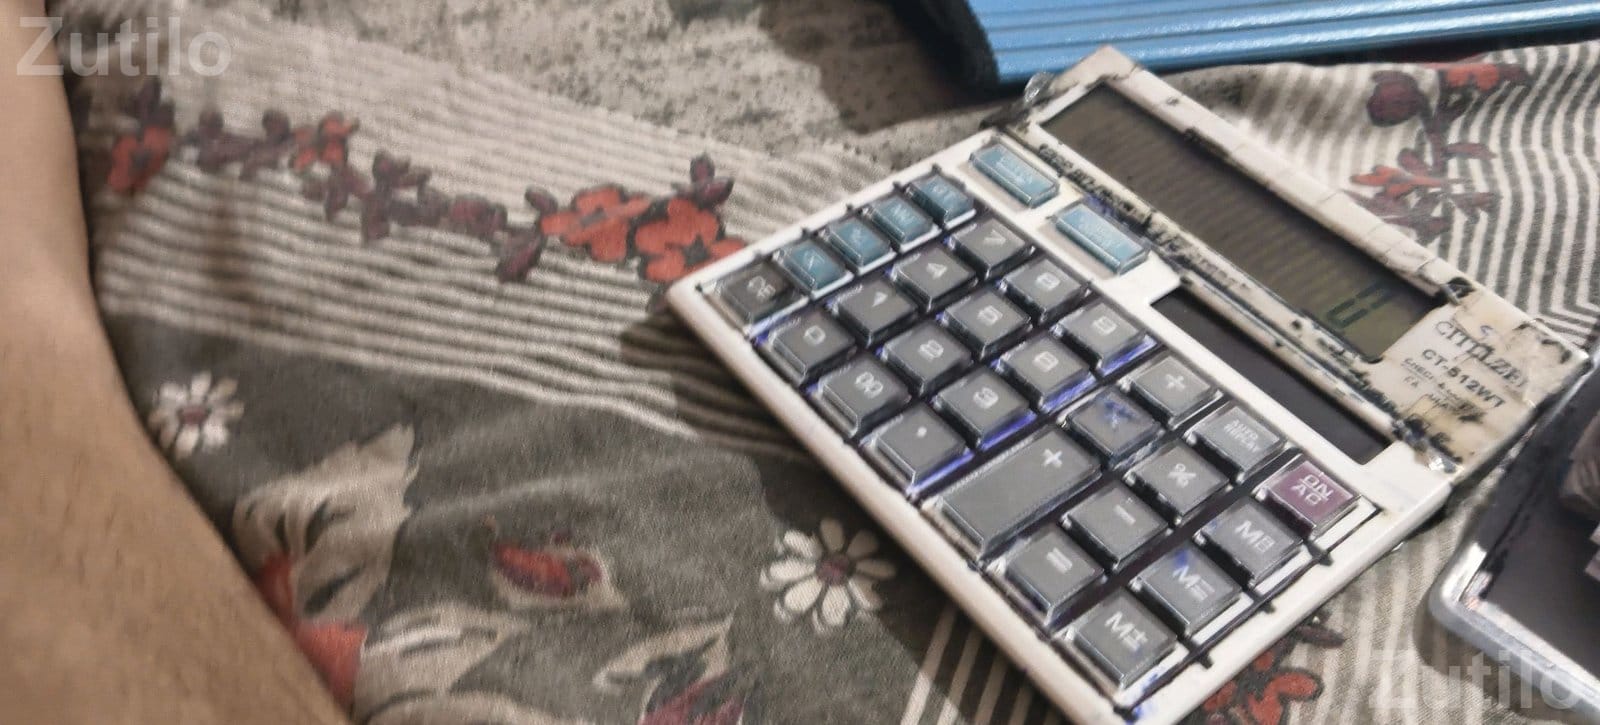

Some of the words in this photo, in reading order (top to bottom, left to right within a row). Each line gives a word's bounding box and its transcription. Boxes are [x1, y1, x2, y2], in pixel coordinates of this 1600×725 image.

[1422, 349, 1505, 408] CT-512WT
[1291, 483, 1322, 506] AC
[1301, 474, 1334, 499] ON
